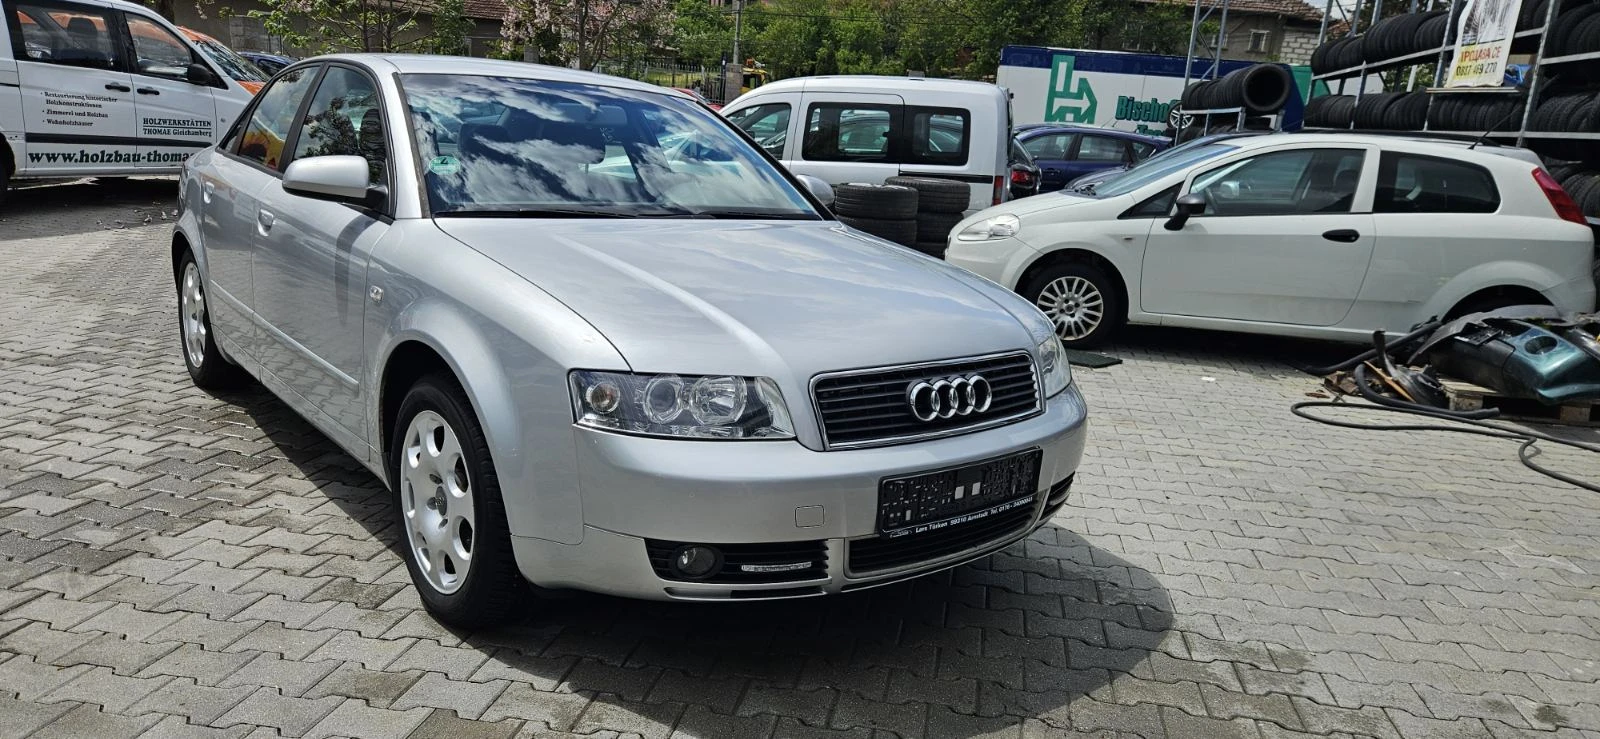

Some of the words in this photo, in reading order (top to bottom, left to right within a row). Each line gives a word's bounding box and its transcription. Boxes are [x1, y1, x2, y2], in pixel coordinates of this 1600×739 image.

[1115, 95, 1181, 123] Bischo
[143, 117, 212, 127] HOLZWERKSTÄTTEN
[172, 129, 212, 137] Gleichamberg
[28, 149, 195, 163] www.holzbau-thoma
